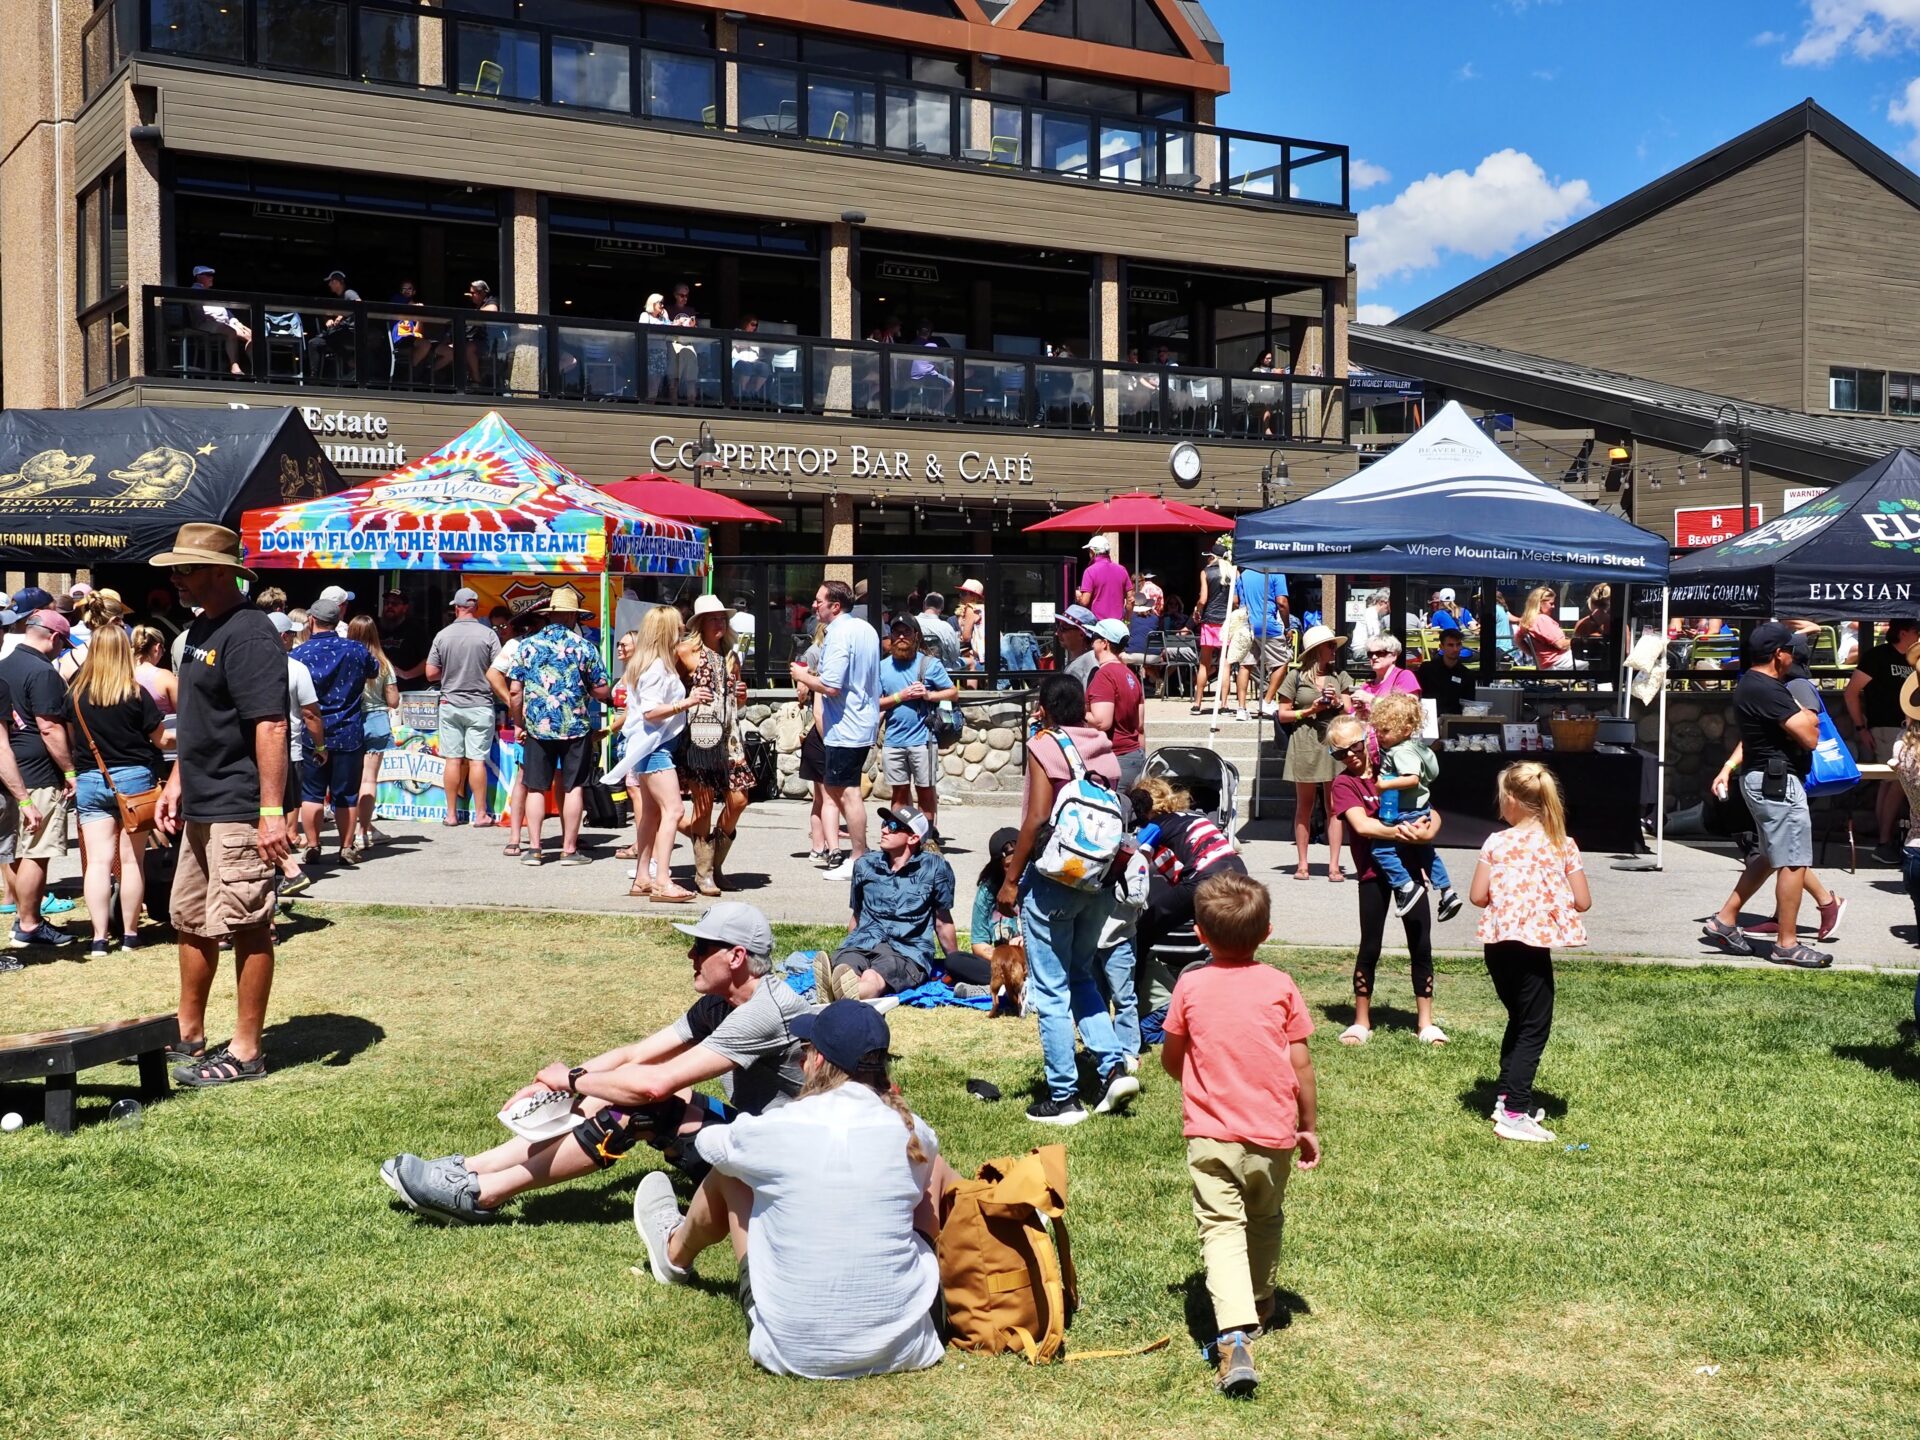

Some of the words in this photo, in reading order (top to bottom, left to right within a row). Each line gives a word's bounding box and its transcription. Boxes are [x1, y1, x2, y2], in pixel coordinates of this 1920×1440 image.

[1361, 379, 1383, 388] HIGHEST
[1384, 380, 1412, 389] DISTILLERY
[302, 406, 388, 434] Estate
[320, 441, 406, 465] ummit
[650, 435, 838, 474] COPERTOP
[850, 445, 912, 478] BAR
[925, 453, 944, 479] &
[958, 450, 1034, 482] CAFÉ
[89, 499, 168, 510] WALKER
[45, 533, 72, 547] BEER
[74, 534, 128, 548] COMPANY
[261, 531, 323, 551] DON'T
[328, 531, 390, 551] FLOAT
[394, 531, 436, 552] THE
[438, 532, 588, 553] MAINSTREAM!
[1255, 539, 1291, 550] Beaver
[1292, 541, 1314, 552] Run
[1317, 542, 1352, 553] Resort
[1406, 543, 1451, 557] Where
[1454, 545, 1518, 560] Mountain
[1521, 549, 1563, 563] Meets
[1566, 551, 1600, 565] Main
[1602, 553, 1646, 567] Street
[1671, 585, 1710, 601] BREWING
[1712, 584, 1759, 601] COMPANY
[1809, 583, 1912, 600] ELYSIAN
[383, 753, 445, 779] EETWATE
